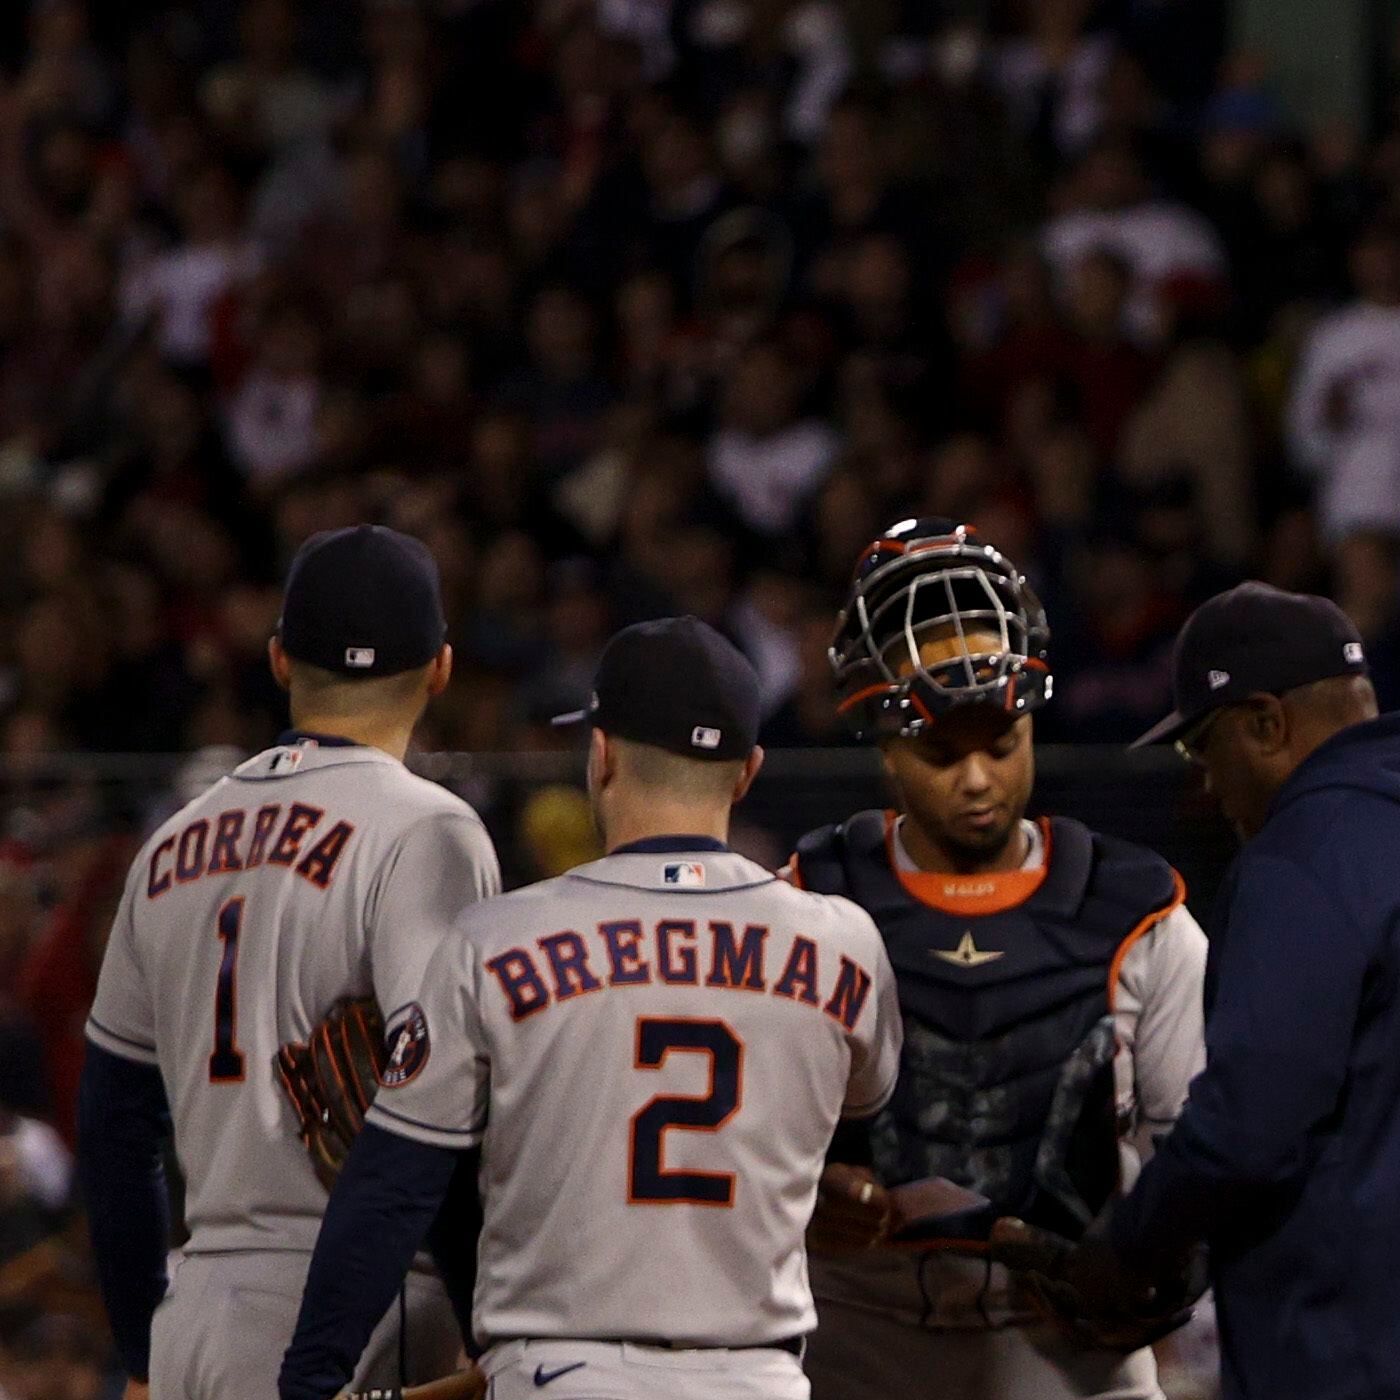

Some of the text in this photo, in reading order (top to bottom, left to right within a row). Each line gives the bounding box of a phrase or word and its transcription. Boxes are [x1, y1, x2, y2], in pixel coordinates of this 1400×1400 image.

[147, 801, 354, 899] CORREA
[209, 895, 246, 1083] 1
[485, 918, 872, 1033] BREGMAN
[627, 1016, 744, 1208] 2
